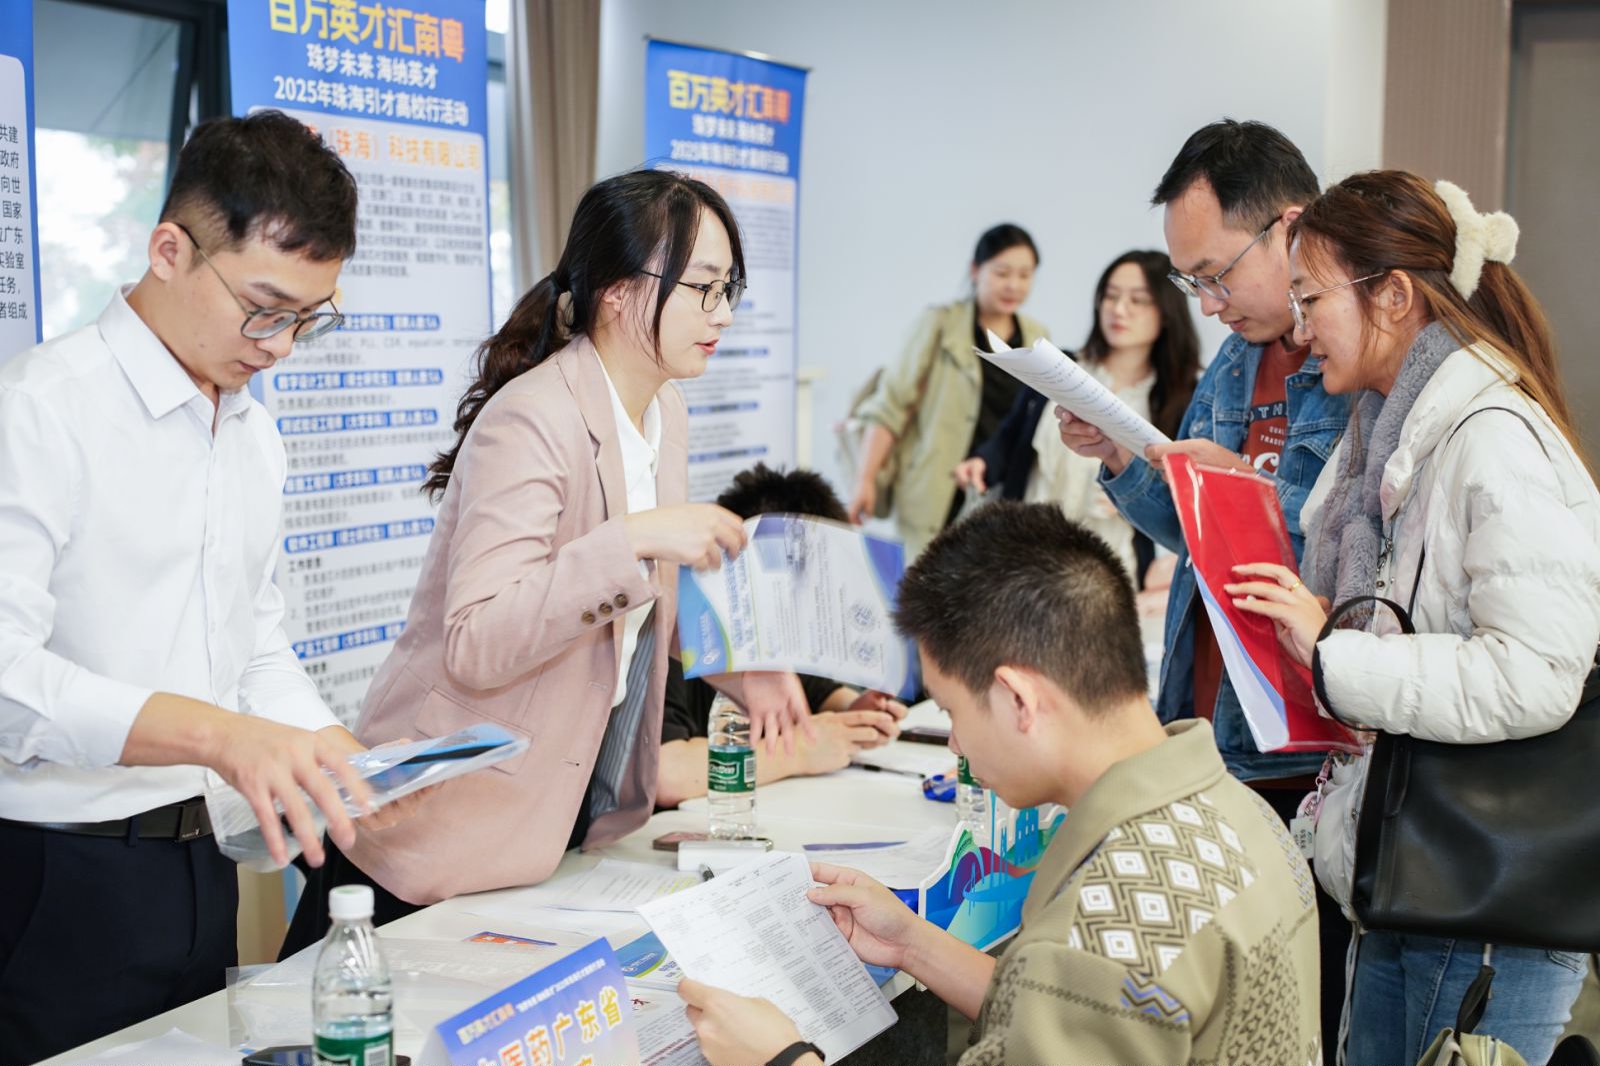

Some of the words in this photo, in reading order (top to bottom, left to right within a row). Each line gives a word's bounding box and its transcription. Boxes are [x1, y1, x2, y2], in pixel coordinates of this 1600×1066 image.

[478, 985, 623, 1066] 医药广东省
